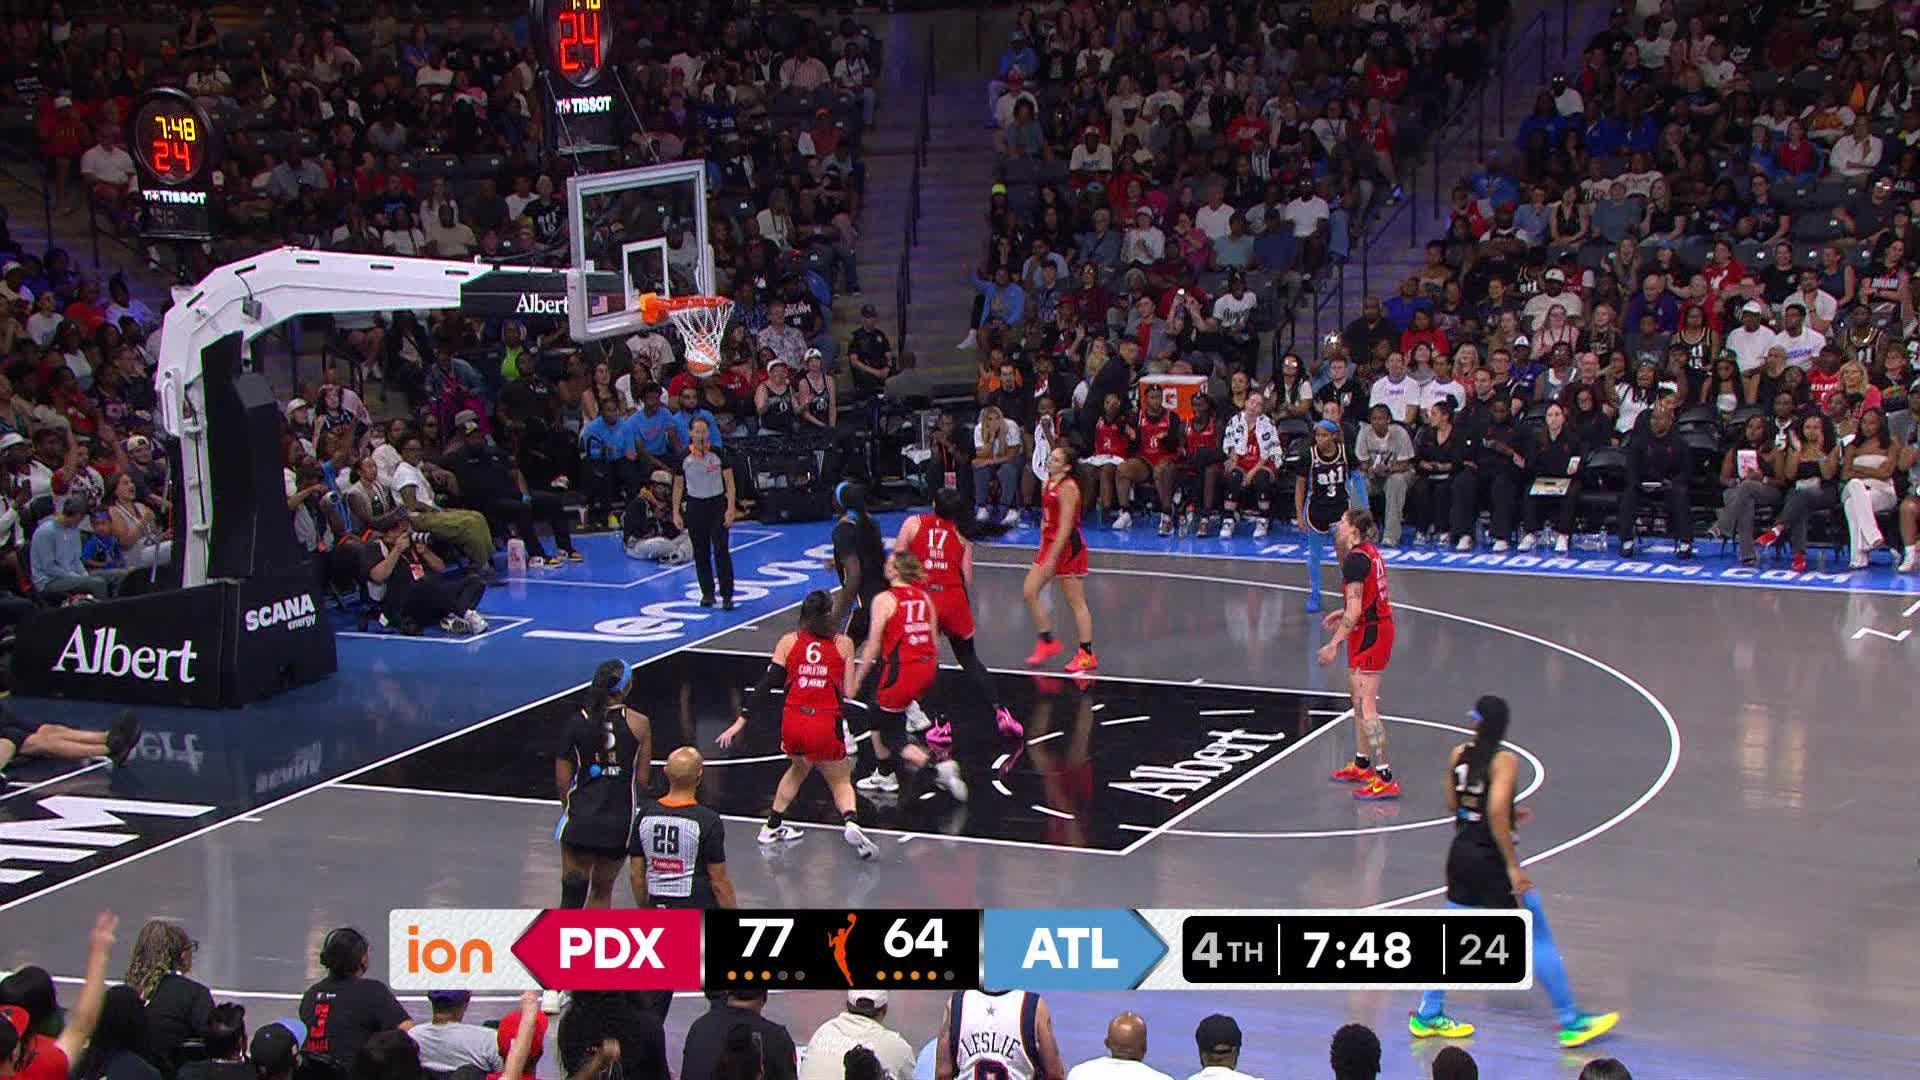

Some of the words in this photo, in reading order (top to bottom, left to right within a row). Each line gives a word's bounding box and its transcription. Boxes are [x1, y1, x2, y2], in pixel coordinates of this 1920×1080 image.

[560, 12, 600, 69] 24
[571, 96, 612, 112] TISSOT
[154, 116, 196, 141] 7:48
[153, 140, 191, 172] 24
[160, 190, 207, 204] TISSOT
[516, 293, 568, 314] Albert
[928, 528, 949, 550] 17
[1258, 543, 1852, 584] AANTADREAM.COM
[245, 593, 316, 632] SCANA
[287, 613, 317, 631] energy
[900, 600, 926, 623] 77
[52, 624, 198, 683] Albert
[805, 641, 822, 664] 6
[1108, 729, 1285, 802] Albert
[652, 823, 680, 855] 29
[961, 1031, 1021, 1060] LESLIE
